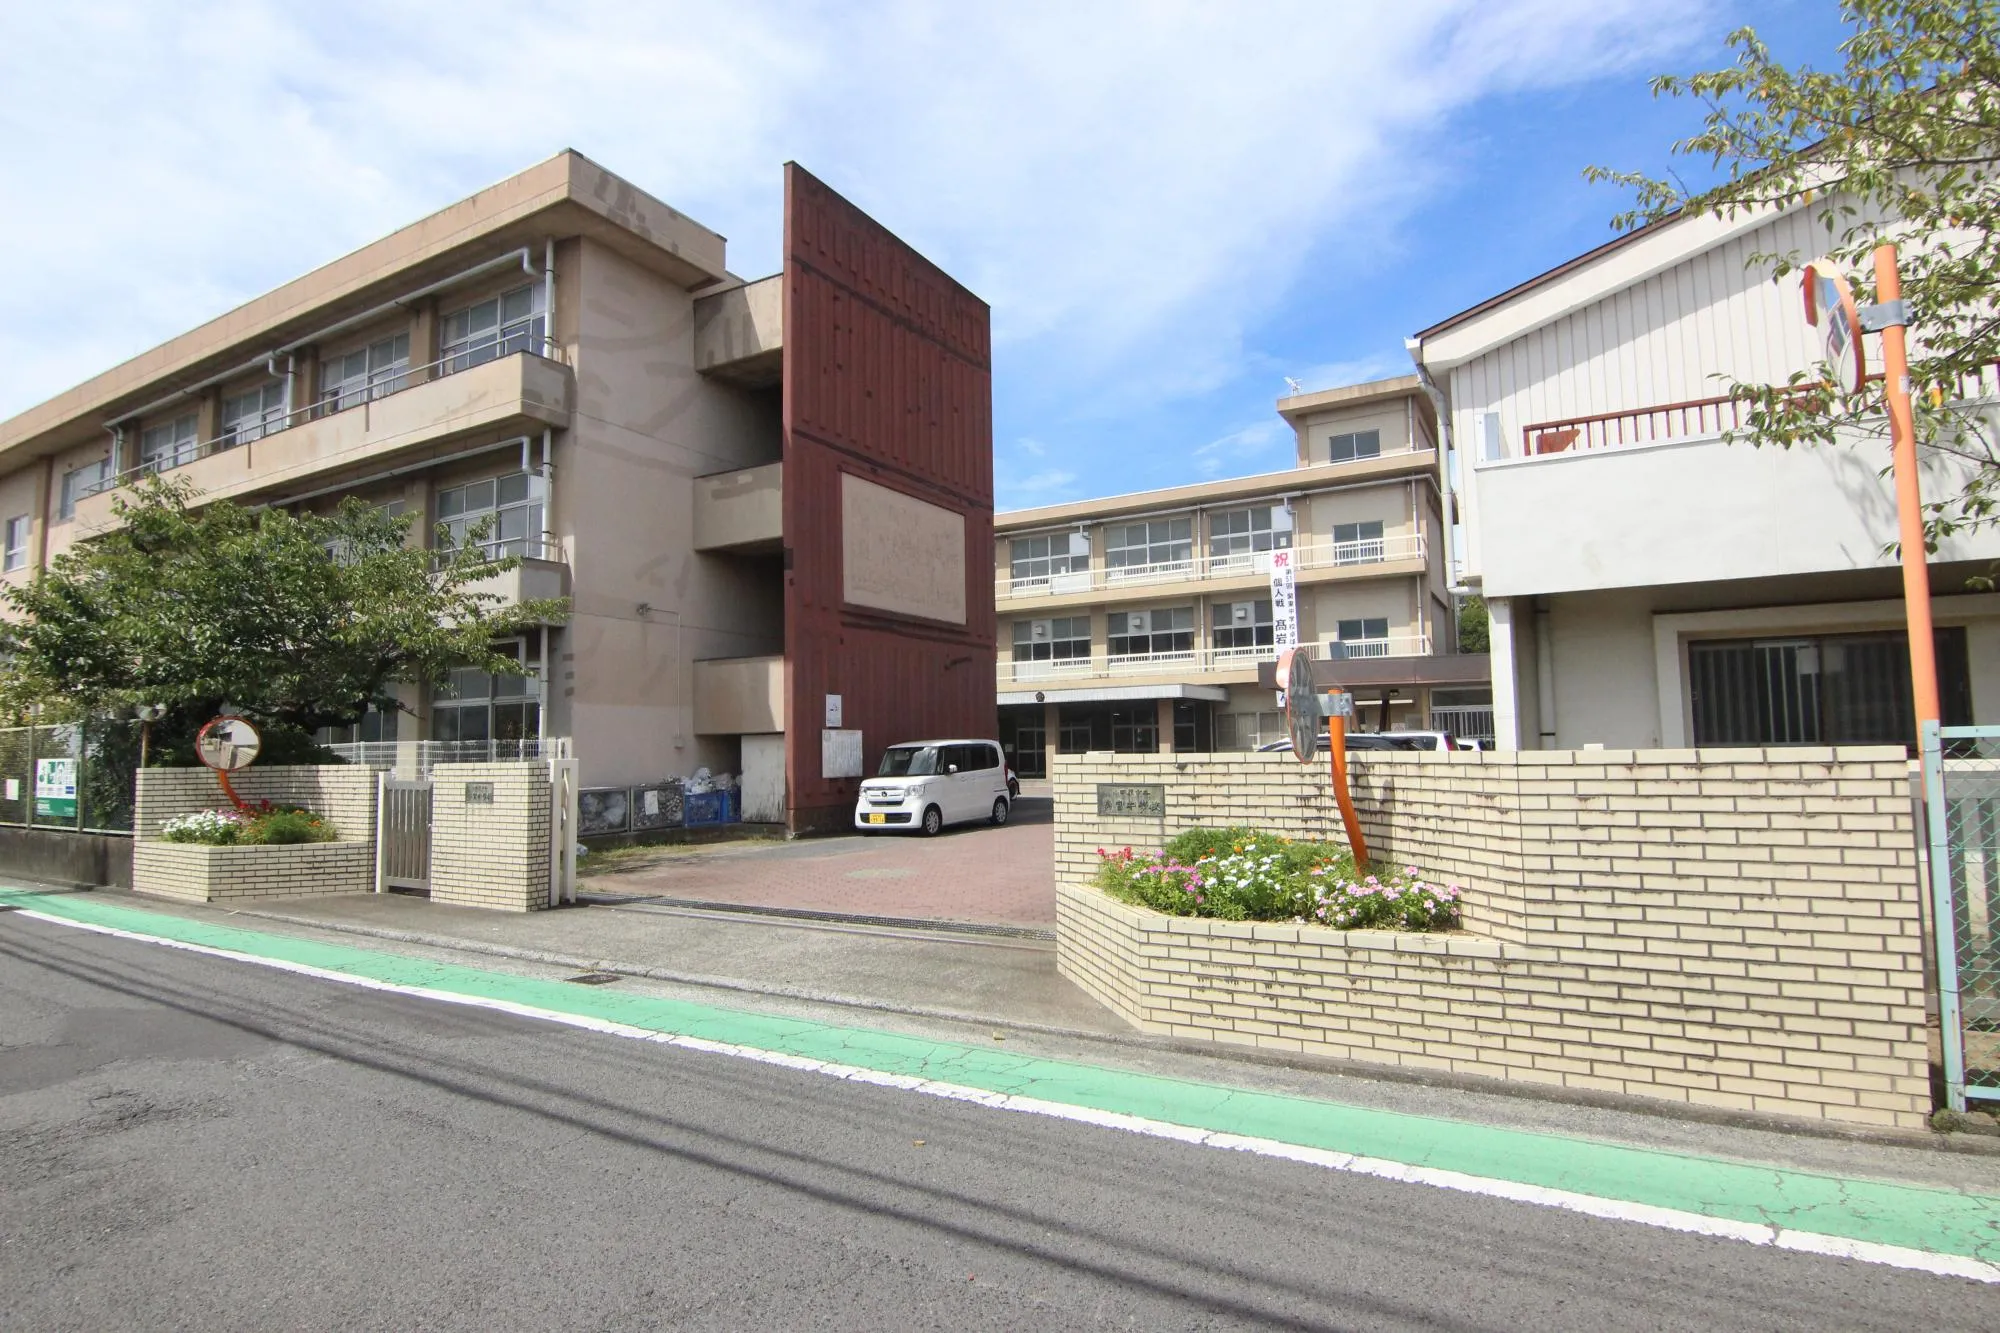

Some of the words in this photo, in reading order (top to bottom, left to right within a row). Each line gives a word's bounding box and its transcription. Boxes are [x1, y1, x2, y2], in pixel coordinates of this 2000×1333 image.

[1274, 552, 1290, 568] 祝
[1273, 577, 1285, 608] 個人戦
